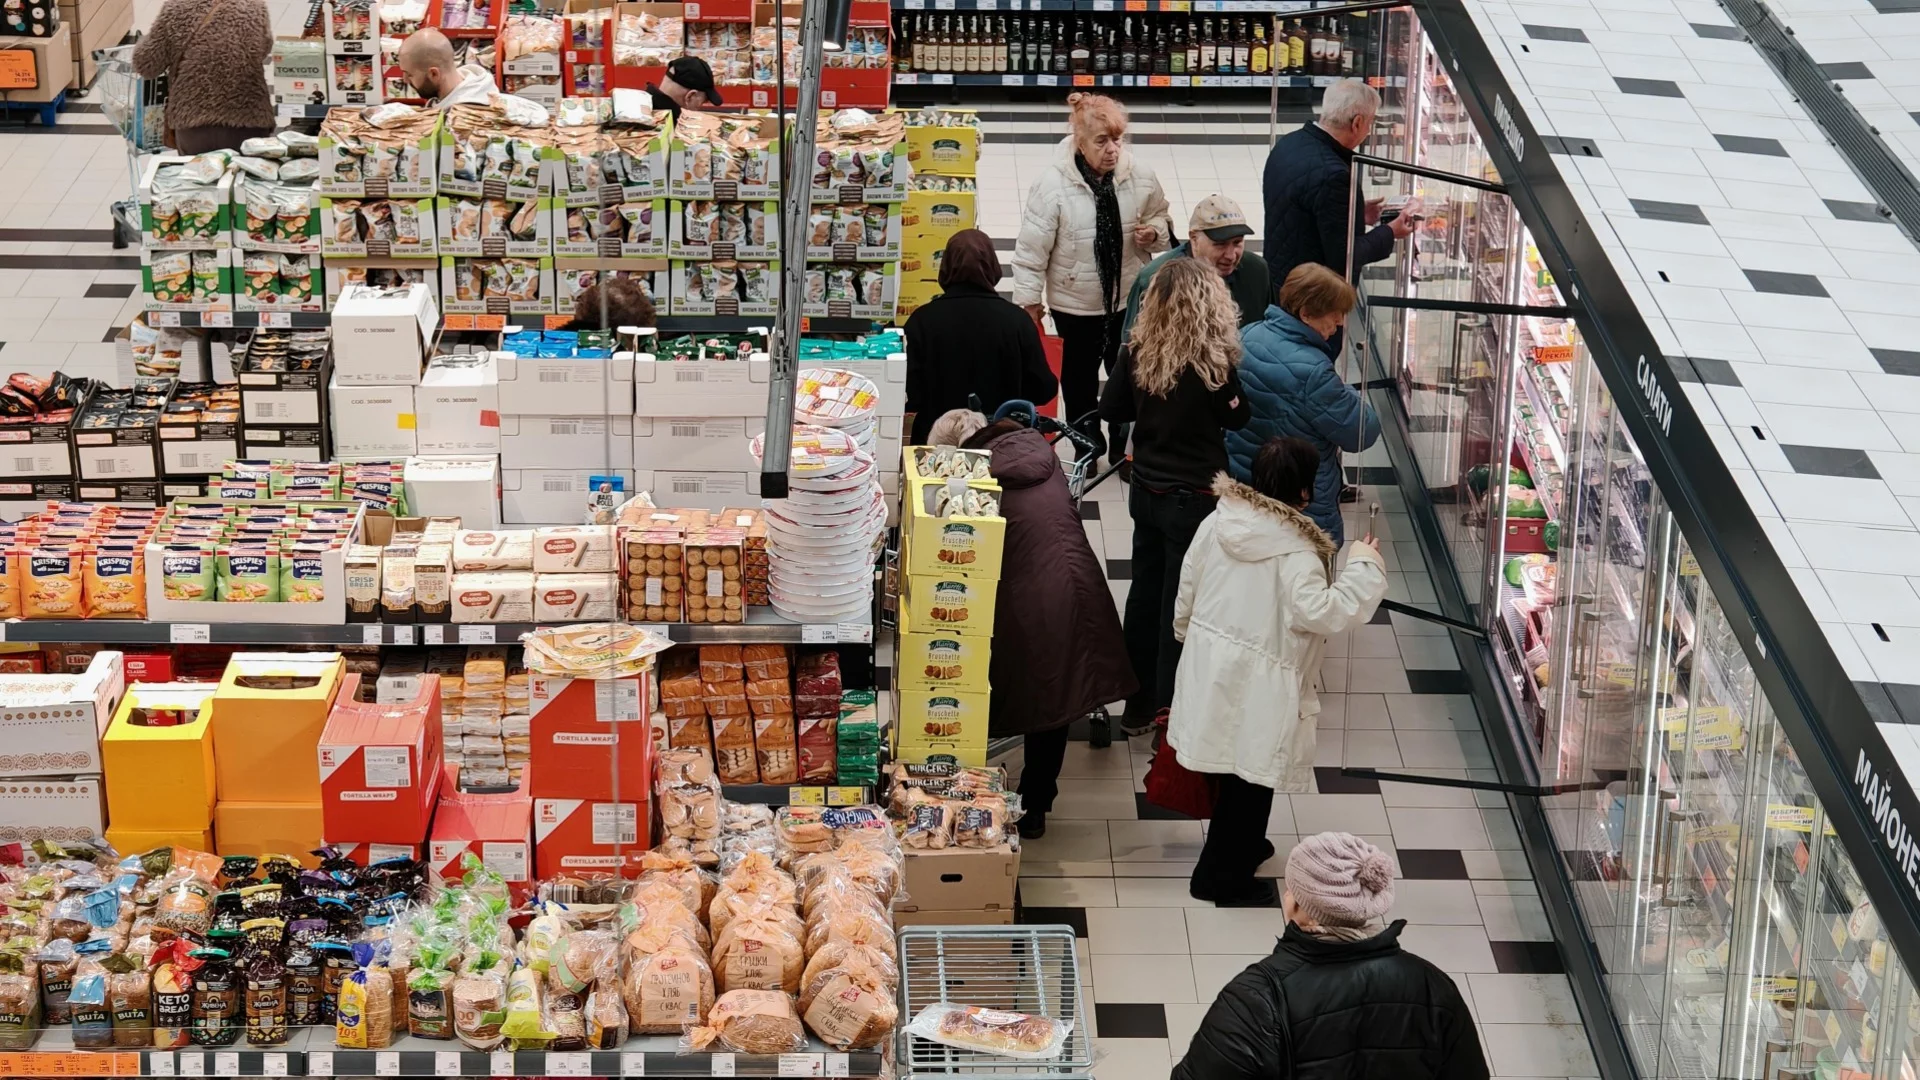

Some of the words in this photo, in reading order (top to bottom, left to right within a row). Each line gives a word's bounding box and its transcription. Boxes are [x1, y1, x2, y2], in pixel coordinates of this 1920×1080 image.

[1637, 354, 1673, 438] САЛАТИ
[546, 543, 574, 551] Bonomi
[32, 558, 69, 567] KRISPIES
[98, 558, 132, 567] KRISPIES
[230, 557, 266, 566] KRISPIES
[294, 560, 322, 568] KRISPIE
[462, 595, 491, 603] Bonomi
[546, 594, 574, 602] Bonomi
[909, 764, 948, 773] BURGERS
[650, 972, 691, 985] ПРОТЕИНОВ
[662, 987, 680, 998] ХЛЯБ
[158, 993, 190, 1005] KETO
[159, 1005, 190, 1014] BREAD
